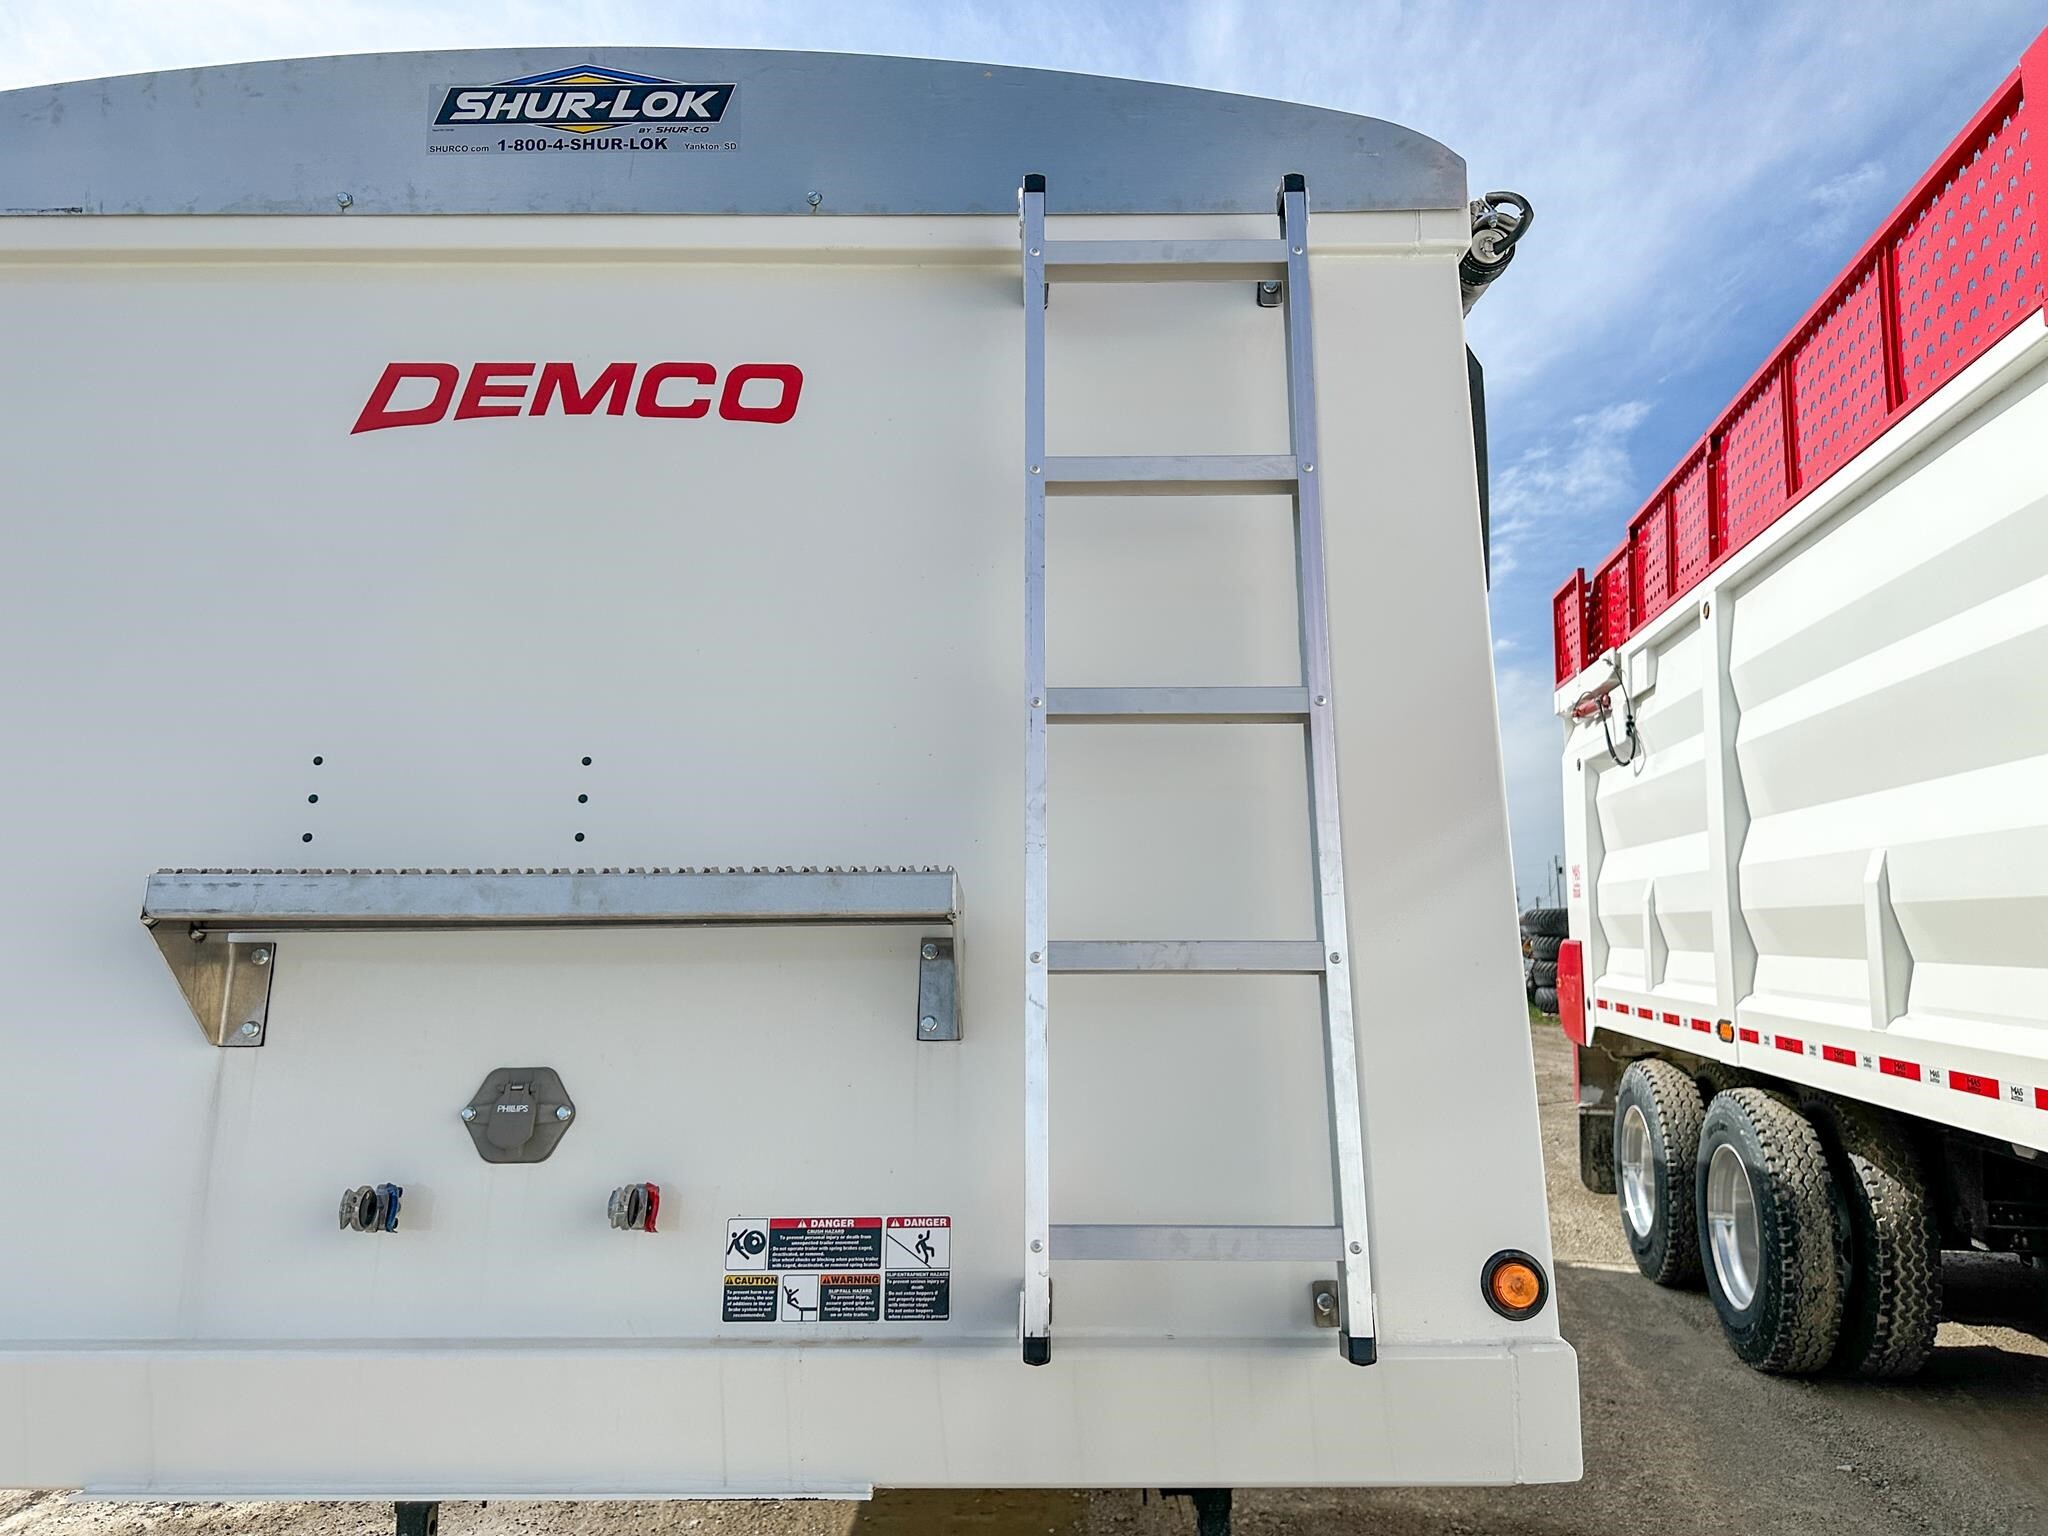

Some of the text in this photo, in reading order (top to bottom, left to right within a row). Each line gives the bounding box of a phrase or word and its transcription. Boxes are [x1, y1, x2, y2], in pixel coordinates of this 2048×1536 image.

[450, 89, 719, 120] SHUR-LOK
[430, 144, 489, 153] SHURCOcom
[498, 137, 668, 151] 1-800-4-SHUR-LOK
[350, 362, 803, 435] DEMCO
[811, 1219, 854, 1227] DANGER
